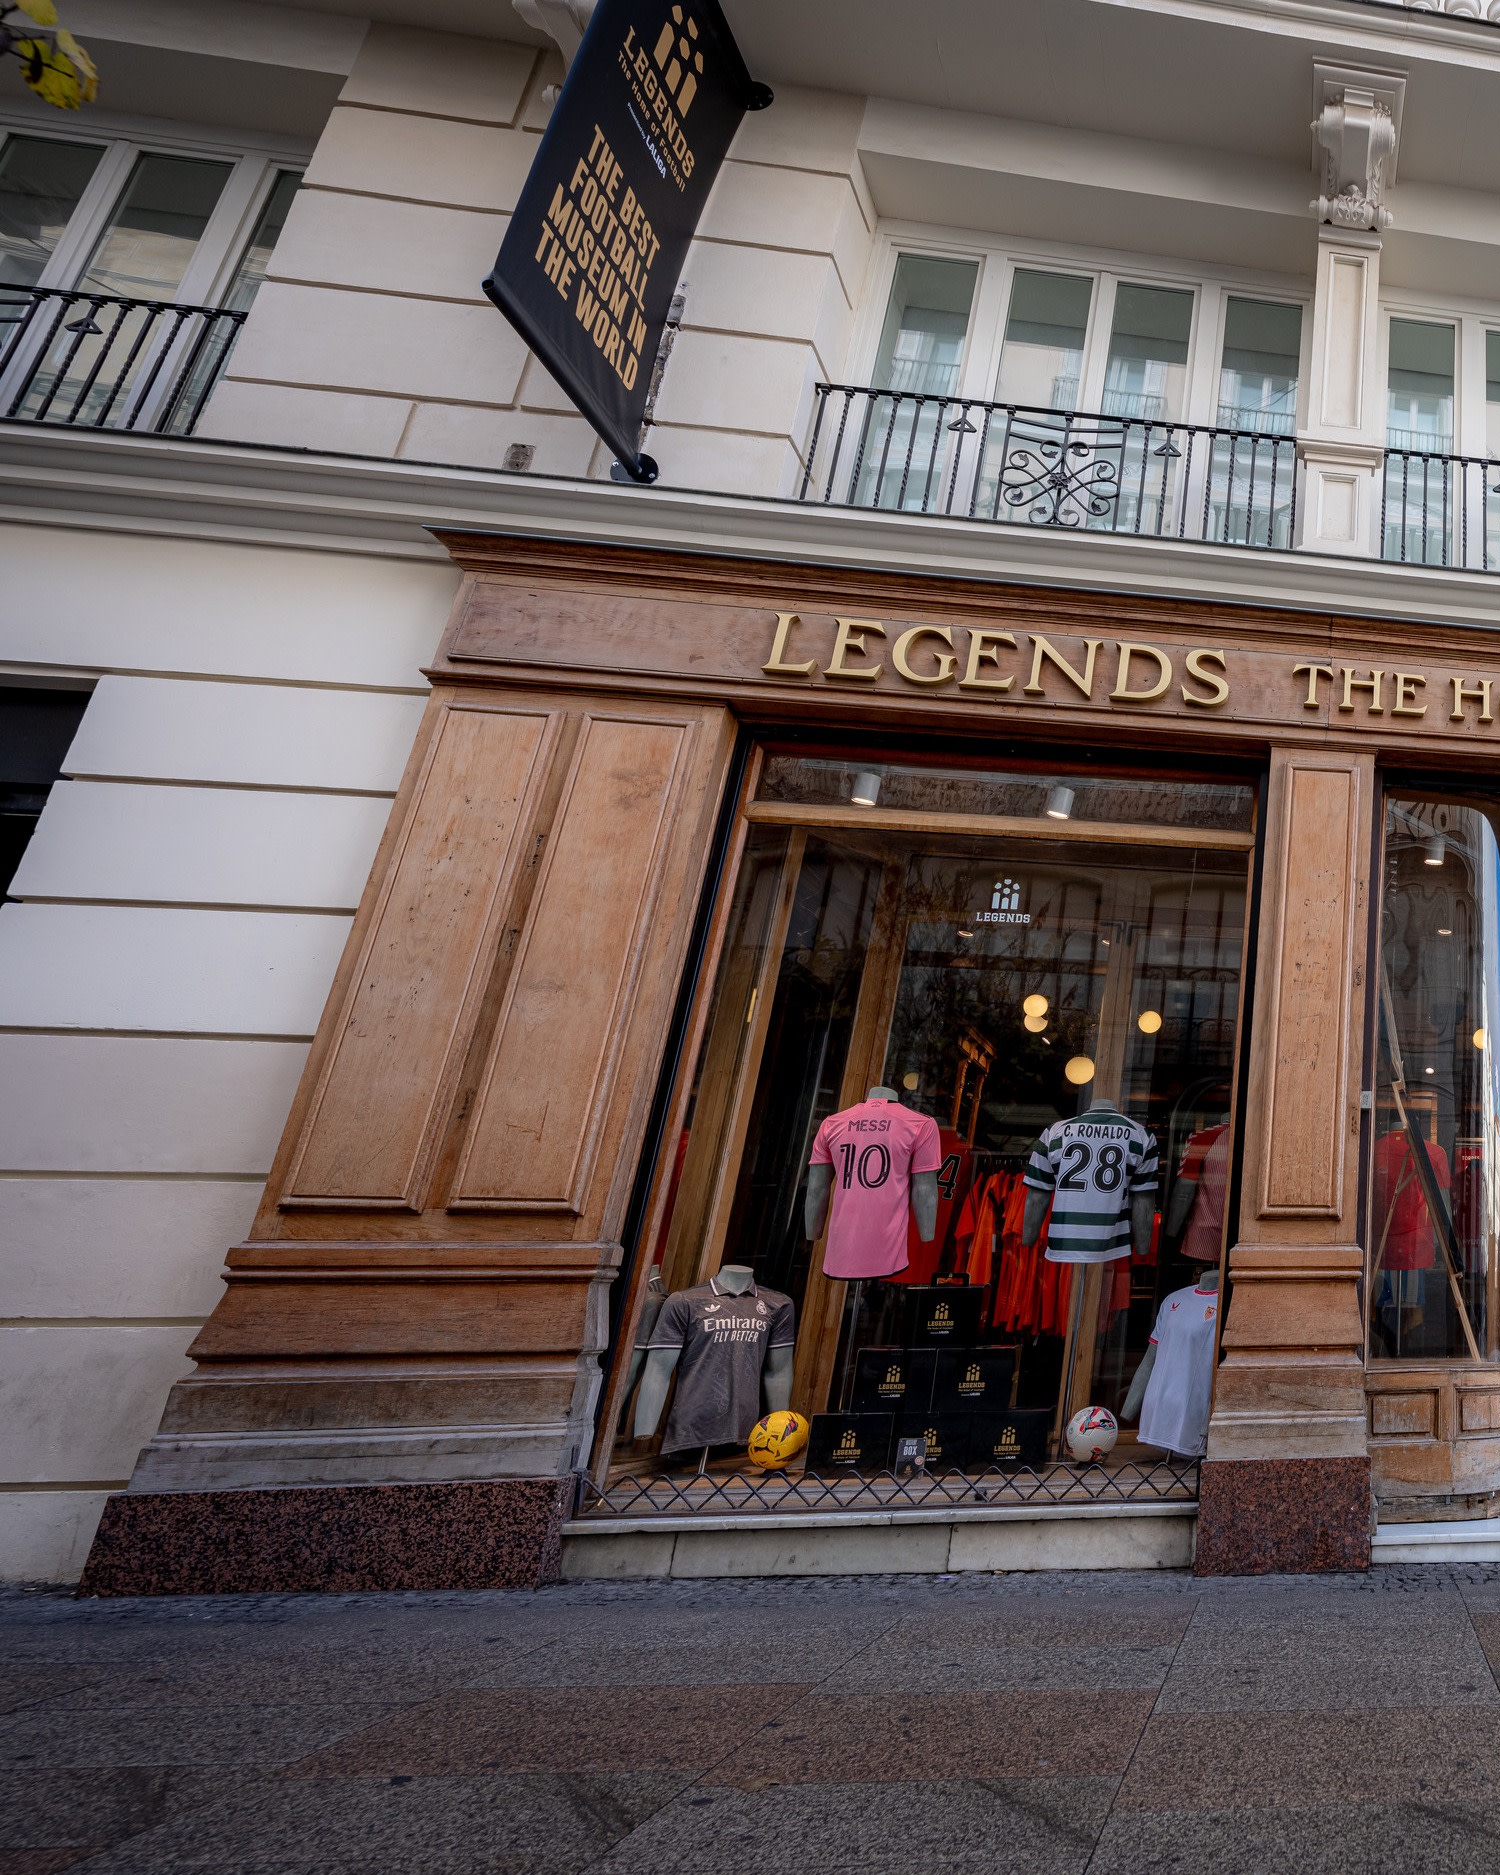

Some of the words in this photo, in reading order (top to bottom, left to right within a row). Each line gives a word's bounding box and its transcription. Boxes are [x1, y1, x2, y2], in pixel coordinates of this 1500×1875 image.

[618, 50, 631, 80] The
[631, 80, 650, 121] Home
[650, 121, 660, 137] of
[659, 137, 686, 193] Football
[623, 25, 695, 178] LEGENDS
[645, 134, 667, 179] LALIGA
[587, 123, 624, 204] THE
[619, 186, 660, 270] BEST
[569, 156, 648, 312] FOOTBALL
[547, 182, 630, 326] MUSEUM
[626, 307, 648, 356] IN
[534, 220, 577, 300] THE
[575, 278, 639, 391] WORLD
[760, 612, 1230, 708] LEGENDS
[1292, 661, 1429, 719] THE
[975, 911, 1031, 923] LEGENDS
[847, 1119, 892, 1132] MESSI
[1063, 1125, 1073, 1137] C.
[1077, 1124, 1131, 1140] RONALDO
[840, 1143, 891, 1190] 10
[1057, 1141, 1125, 1194] 28
[703, 1315, 767, 1333] Emirates
[713, 1330, 730, 1343] FLY
[730, 1330, 759, 1343] BETTER
[832, 1448, 861, 1456] LEGENDS
[903, 1446, 918, 1456] BOX
